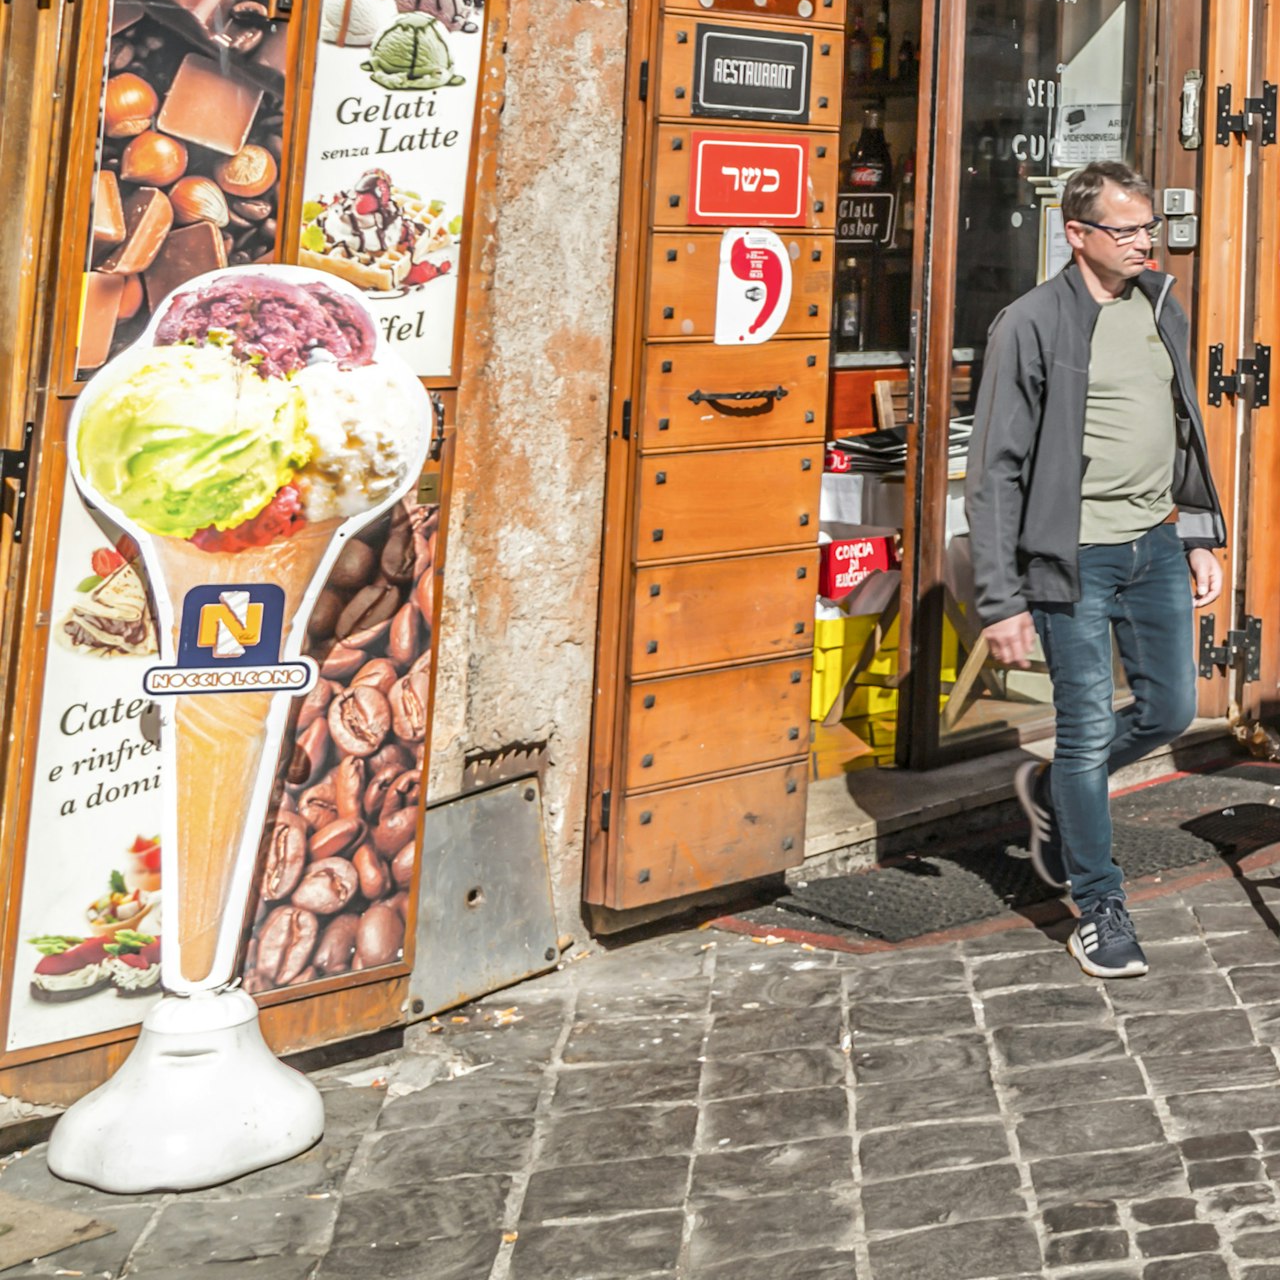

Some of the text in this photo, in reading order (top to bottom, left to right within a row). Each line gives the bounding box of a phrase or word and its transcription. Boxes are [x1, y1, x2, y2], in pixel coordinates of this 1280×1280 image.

[713, 58, 796, 90] RESTAURANT
[336, 91, 437, 125] Gelati
[320, 126, 459, 161] senza Latte
[721, 166, 781, 193] כשר
[839, 200, 875, 218] Glatt
[836, 219, 879, 237] osher
[152, 669, 304, 689] NOCCIOLCONO
[48, 764, 64, 782] e
[60, 798, 76, 817] a
